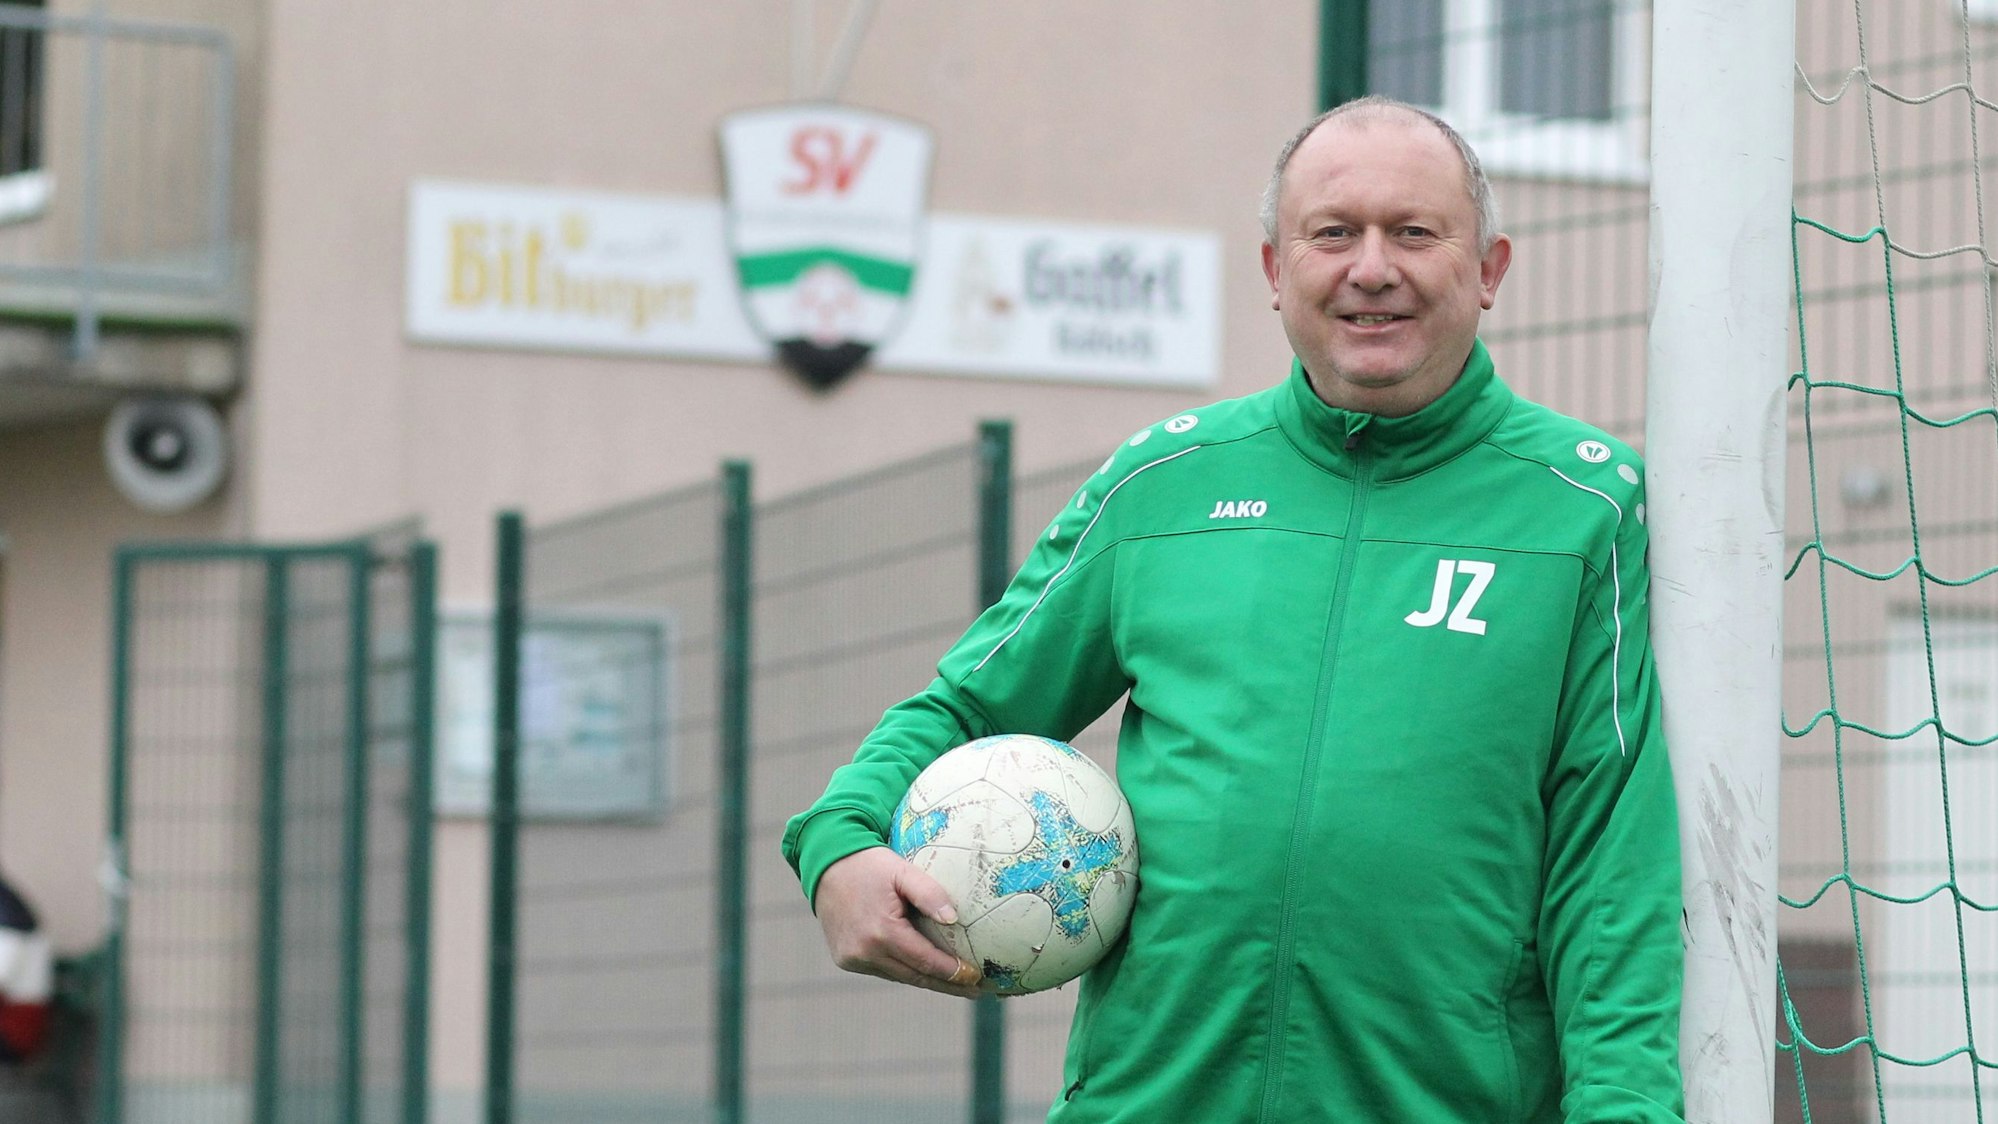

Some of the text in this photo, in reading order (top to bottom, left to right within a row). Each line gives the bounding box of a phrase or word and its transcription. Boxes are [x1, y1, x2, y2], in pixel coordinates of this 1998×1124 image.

[780, 125, 877, 197] SV
[1208, 499, 1268, 519] JAKO
[1403, 558, 1496, 636] JZ
